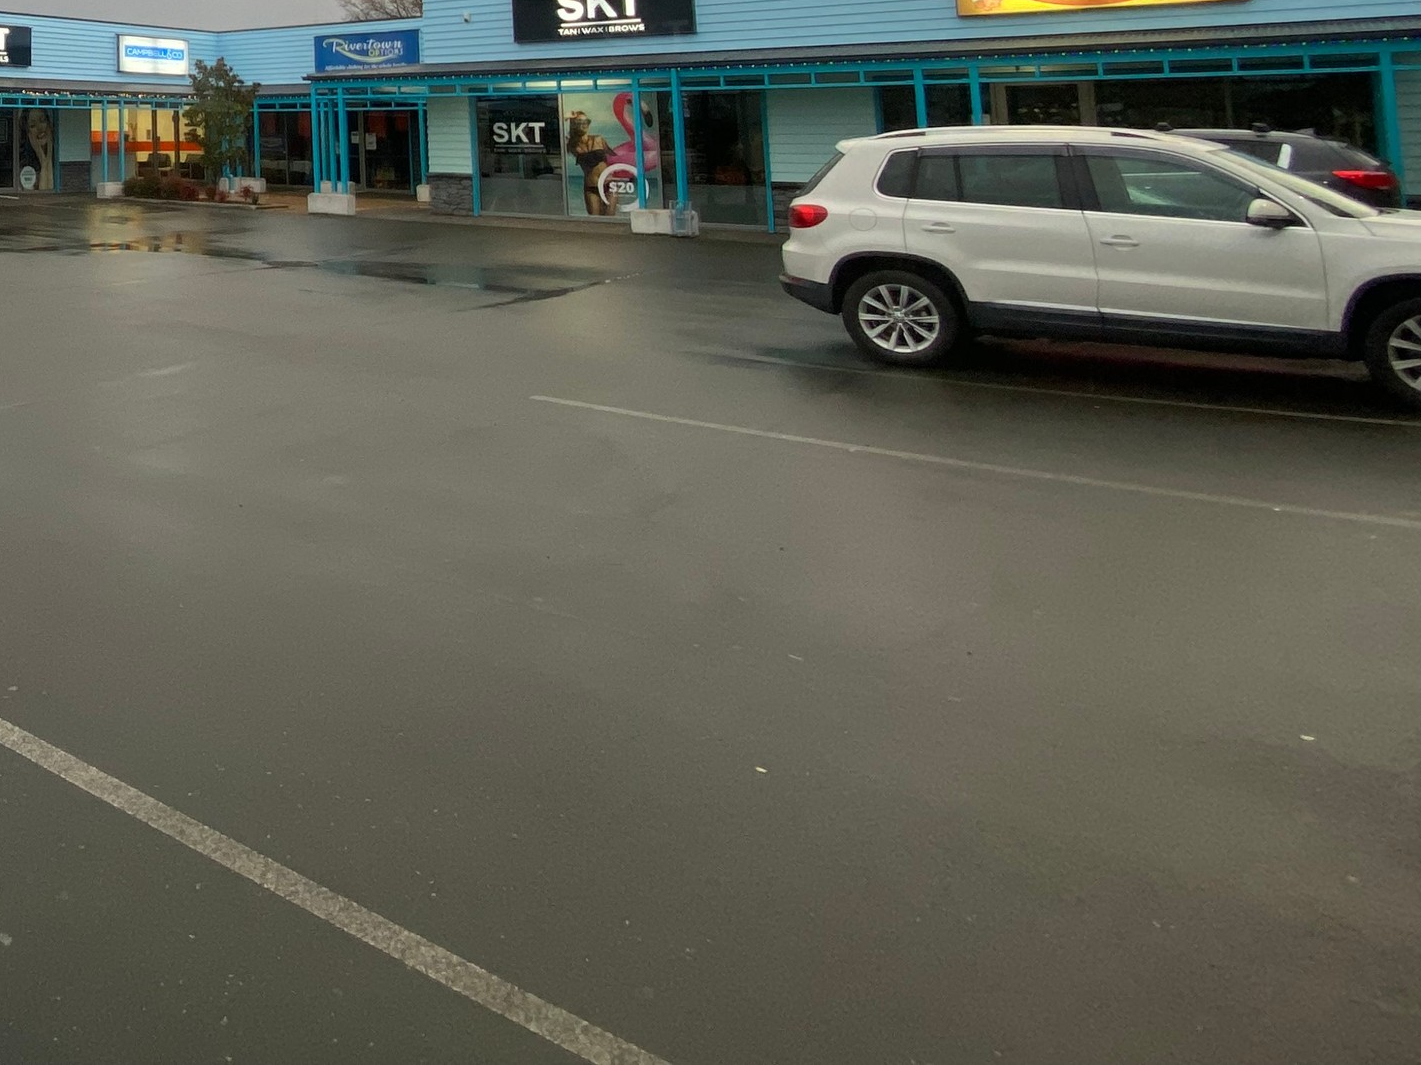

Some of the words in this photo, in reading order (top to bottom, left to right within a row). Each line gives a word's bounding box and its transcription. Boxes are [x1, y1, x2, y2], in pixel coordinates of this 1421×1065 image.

[557, 27, 578, 36] TAN
[581, 25, 604, 35] WAX
[608, 23, 645, 33] BROWS
[323, 38, 403, 53] Rivertown
[492, 122, 546, 144] SKT
[609, 181, 635, 194] $20
